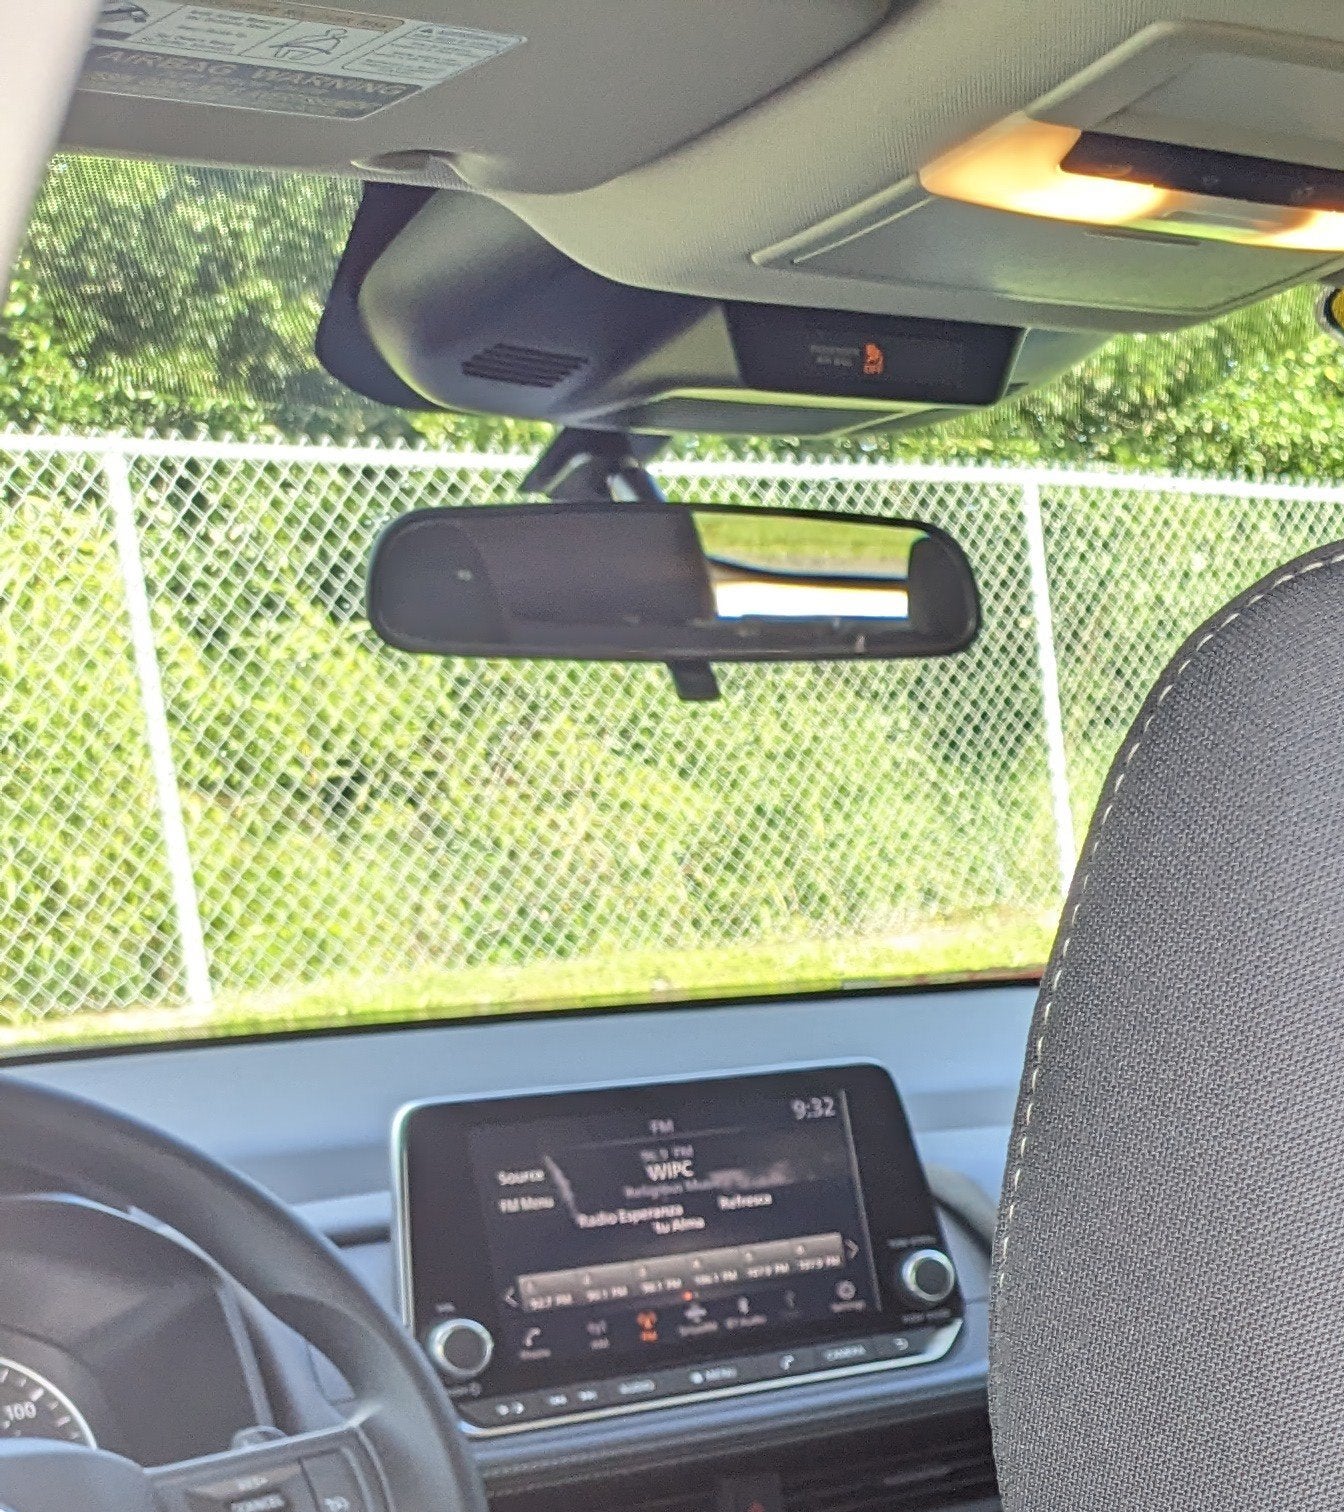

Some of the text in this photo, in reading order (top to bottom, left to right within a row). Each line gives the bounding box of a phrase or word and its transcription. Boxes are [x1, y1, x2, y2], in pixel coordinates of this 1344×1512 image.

[96, 50, 238, 77] AIRBAG
[250, 66, 409, 96] WARNING
[792, 1096, 836, 1120] 9:32
[4, 1400, 37, 1421] 100
